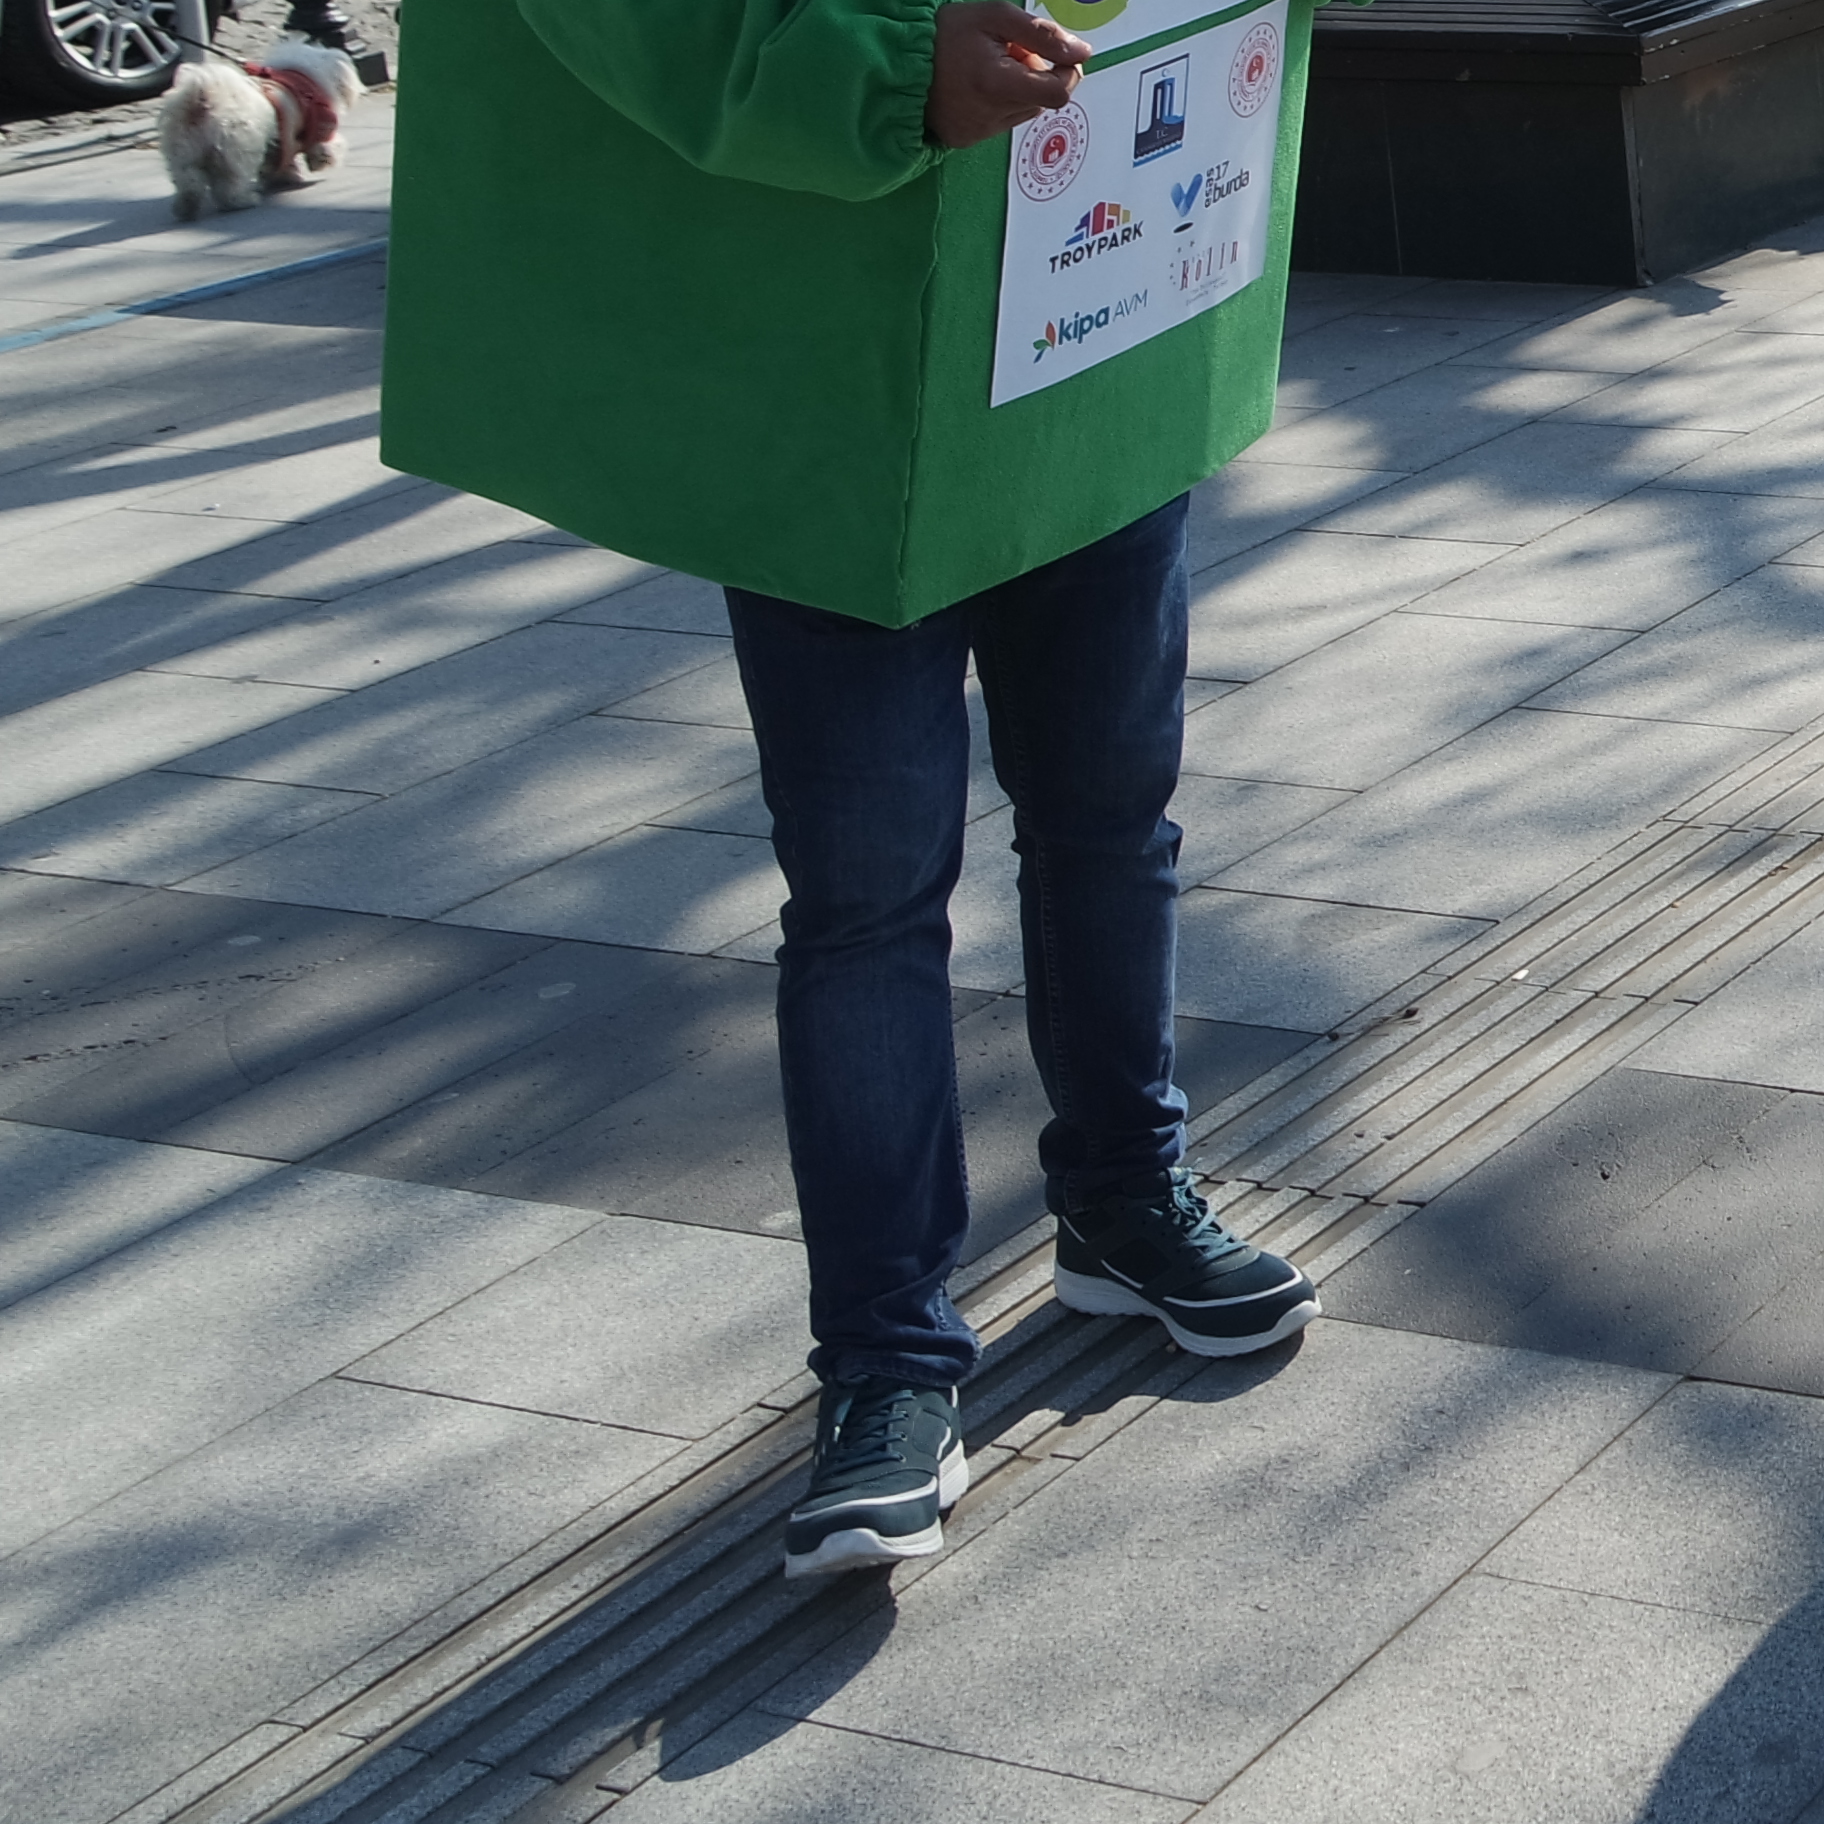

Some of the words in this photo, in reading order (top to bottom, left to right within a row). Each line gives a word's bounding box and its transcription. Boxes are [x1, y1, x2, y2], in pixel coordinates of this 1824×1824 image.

[1212, 168, 1250, 204] burda
[1215, 160, 1230, 182] 17
[1049, 220, 1144, 274] TROYPARK
[1058, 305, 1110, 346] kipa
[1112, 289, 1149, 323] AVM
